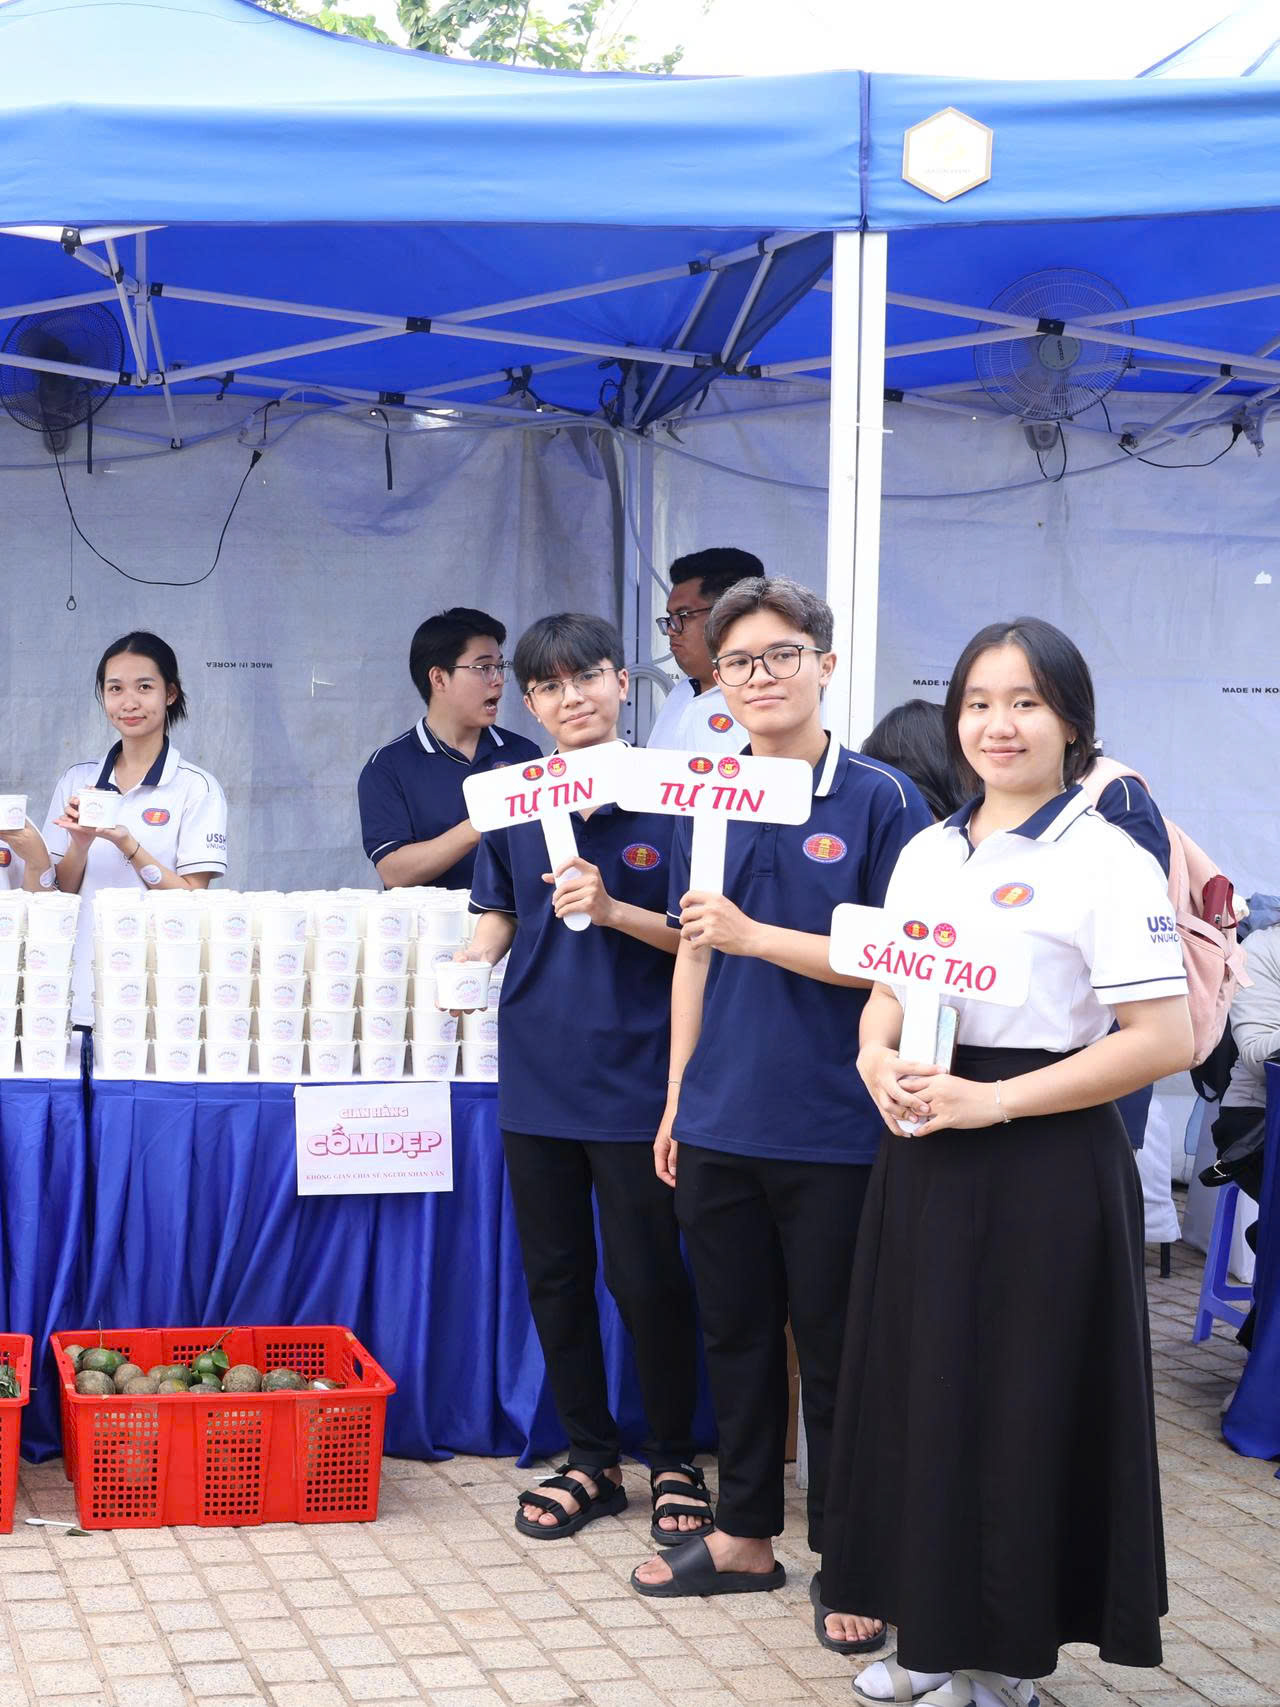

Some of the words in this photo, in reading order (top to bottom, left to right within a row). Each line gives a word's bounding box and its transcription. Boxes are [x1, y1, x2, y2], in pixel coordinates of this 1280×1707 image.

[505, 786, 543, 818] TỰ
[548, 777, 594, 807] TIN
[659, 782, 705, 812] TỰ
[711, 786, 765, 812] TIN
[858, 941, 936, 981] SÁNG
[945, 958, 997, 993] TẠO
[306, 1123, 379, 1156] CỐM
[382, 1131, 442, 1159] DẸP
